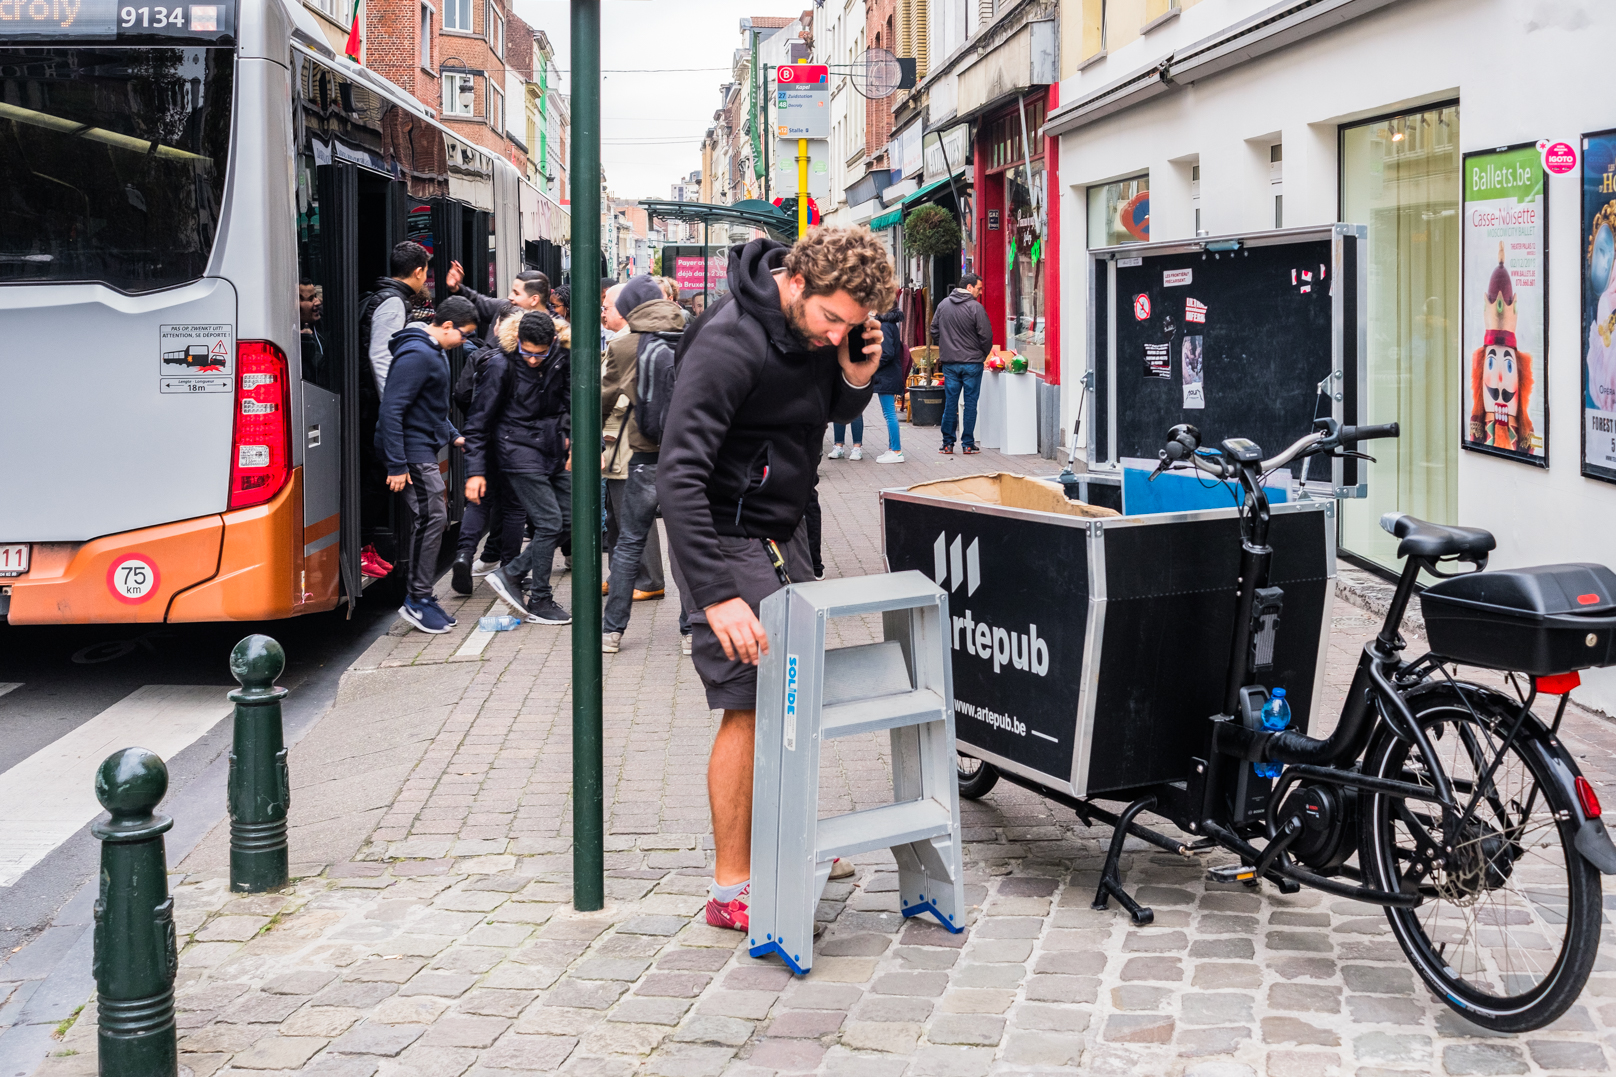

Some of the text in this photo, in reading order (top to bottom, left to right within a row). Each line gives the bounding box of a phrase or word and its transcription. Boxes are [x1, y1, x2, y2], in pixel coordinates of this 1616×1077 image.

[121, 6, 184, 28] 9134
[1548, 155, 1574, 163] IGOTO
[1472, 162, 1531, 191] Ballets.be
[1472, 207, 1536, 227] Casse-Noisette
[1518, 226, 1536, 236] BALLET
[678, 270, 693, 278] déjà
[1592, 416, 1614, 433] FOREST
[121, 566, 147, 585] 75
[126, 586, 141, 594] km
[950, 609, 1050, 677] rtepub
[787, 656, 797, 715] SOLIDE
[954, 698, 1027, 736] www.artepub.be
